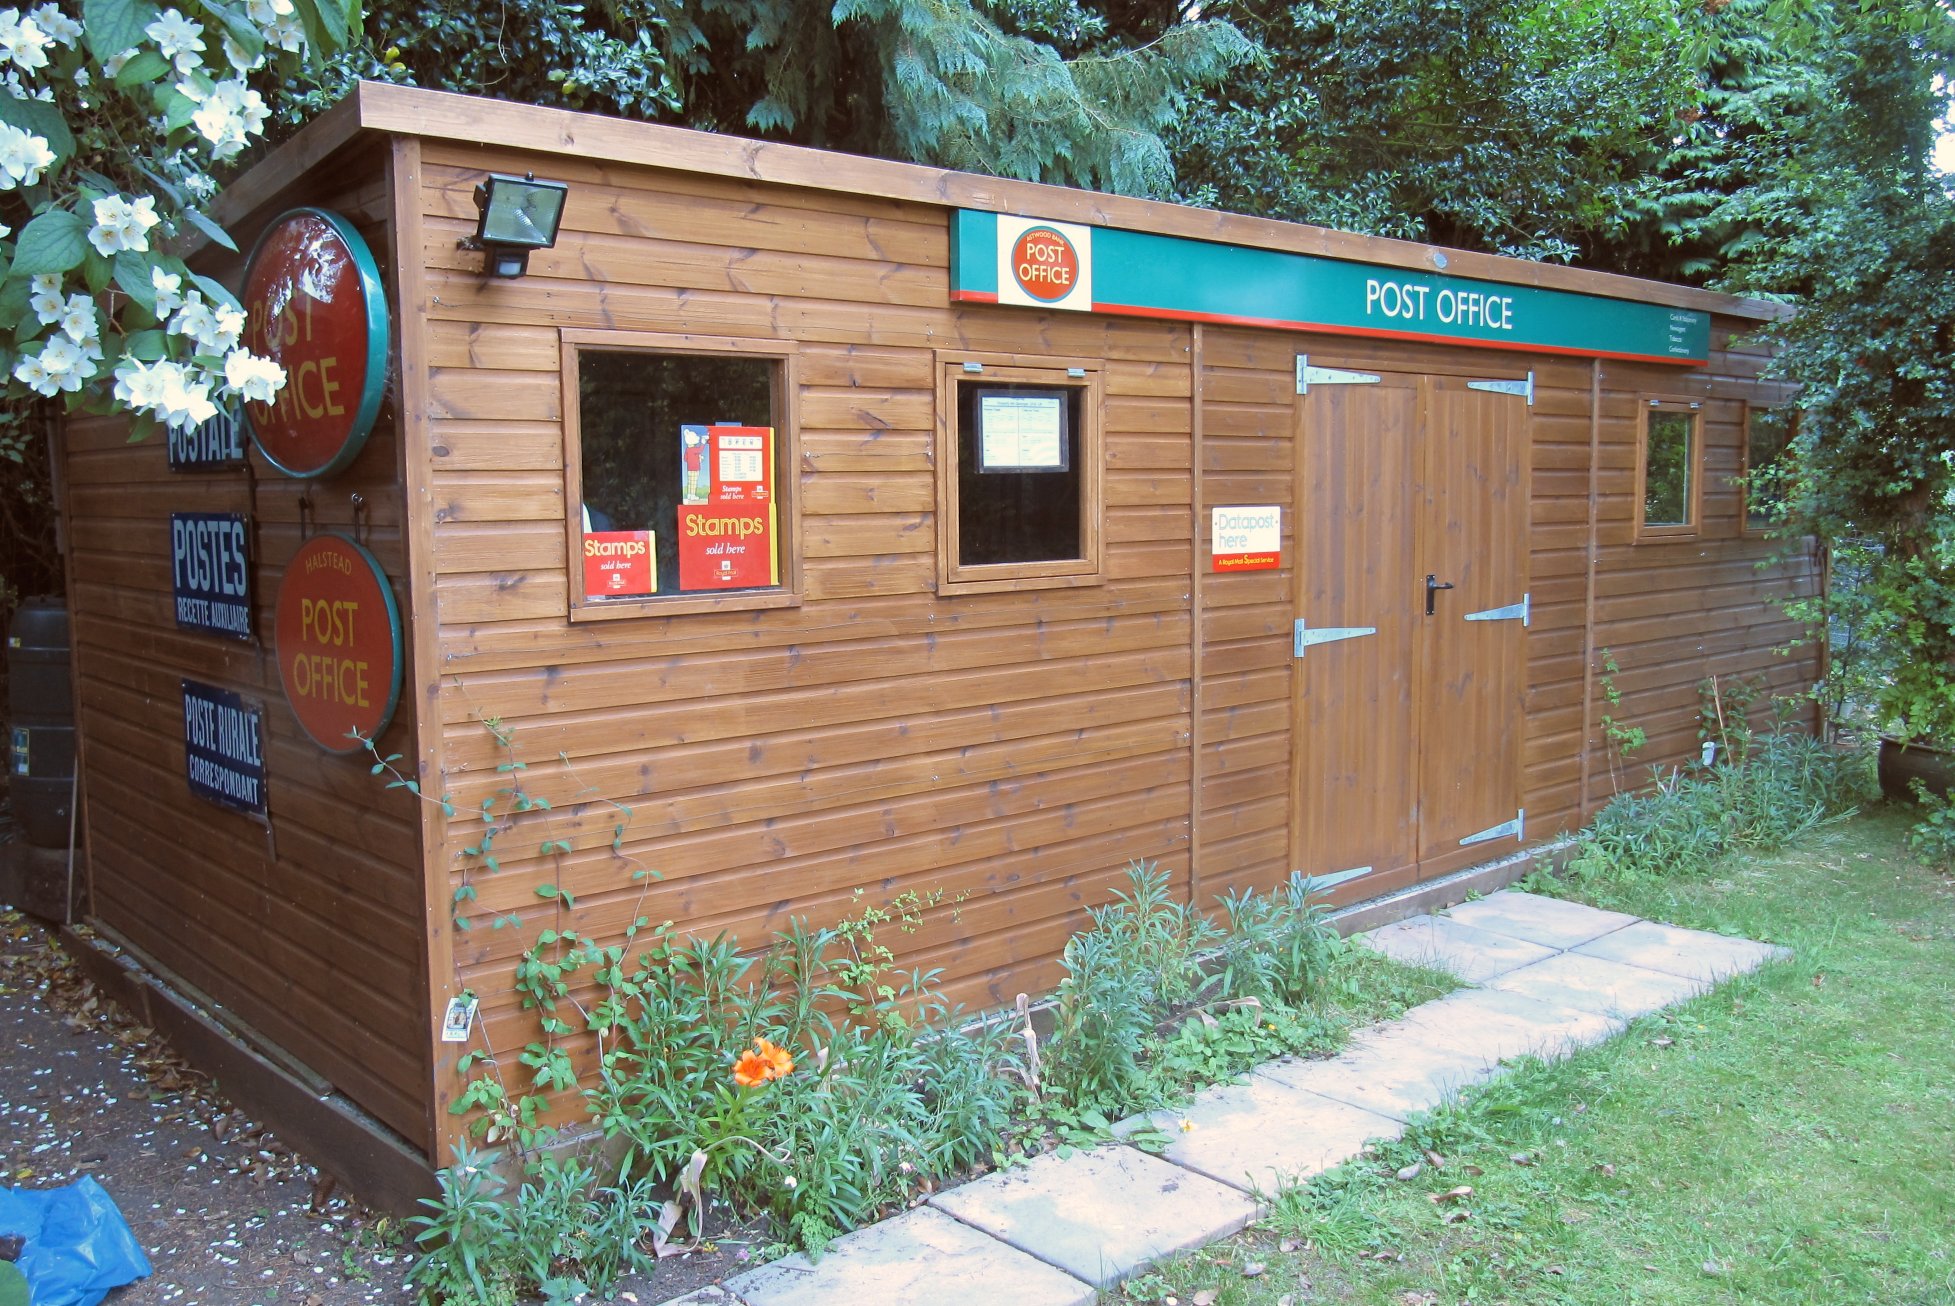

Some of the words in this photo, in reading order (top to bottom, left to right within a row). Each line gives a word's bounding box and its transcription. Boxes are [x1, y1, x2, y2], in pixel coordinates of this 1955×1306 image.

[1026, 243, 1065, 263] POST
[1019, 264, 1070, 284] OFFICE
[1366, 279, 1430, 320] POST
[1435, 289, 1513, 330] OFFICE
[252, 289, 313, 354] POST
[722, 485, 742, 494] Stamps
[686, 513, 764, 540] Stamps
[1219, 513, 1274, 532] Datapost
[584, 539, 646, 559] Stamps
[705, 543, 724, 556] sold
[725, 542, 746, 555] here
[1219, 533, 1248, 549] here
[173, 519, 247, 597] POSTES
[305, 551, 352, 576] HALSTEAD
[600, 561, 615, 571] sold
[616, 560, 632, 570] here
[177, 596, 210, 626] RECETTE
[211, 601, 250, 634] AUXILIAIRE
[301, 598, 359, 648] POST
[293, 652, 370, 708] OFFICE
[184, 693, 216, 752] POSTE
[217, 703, 261, 767] RURALE
[189, 753, 259, 806] CORRESPONDANT
